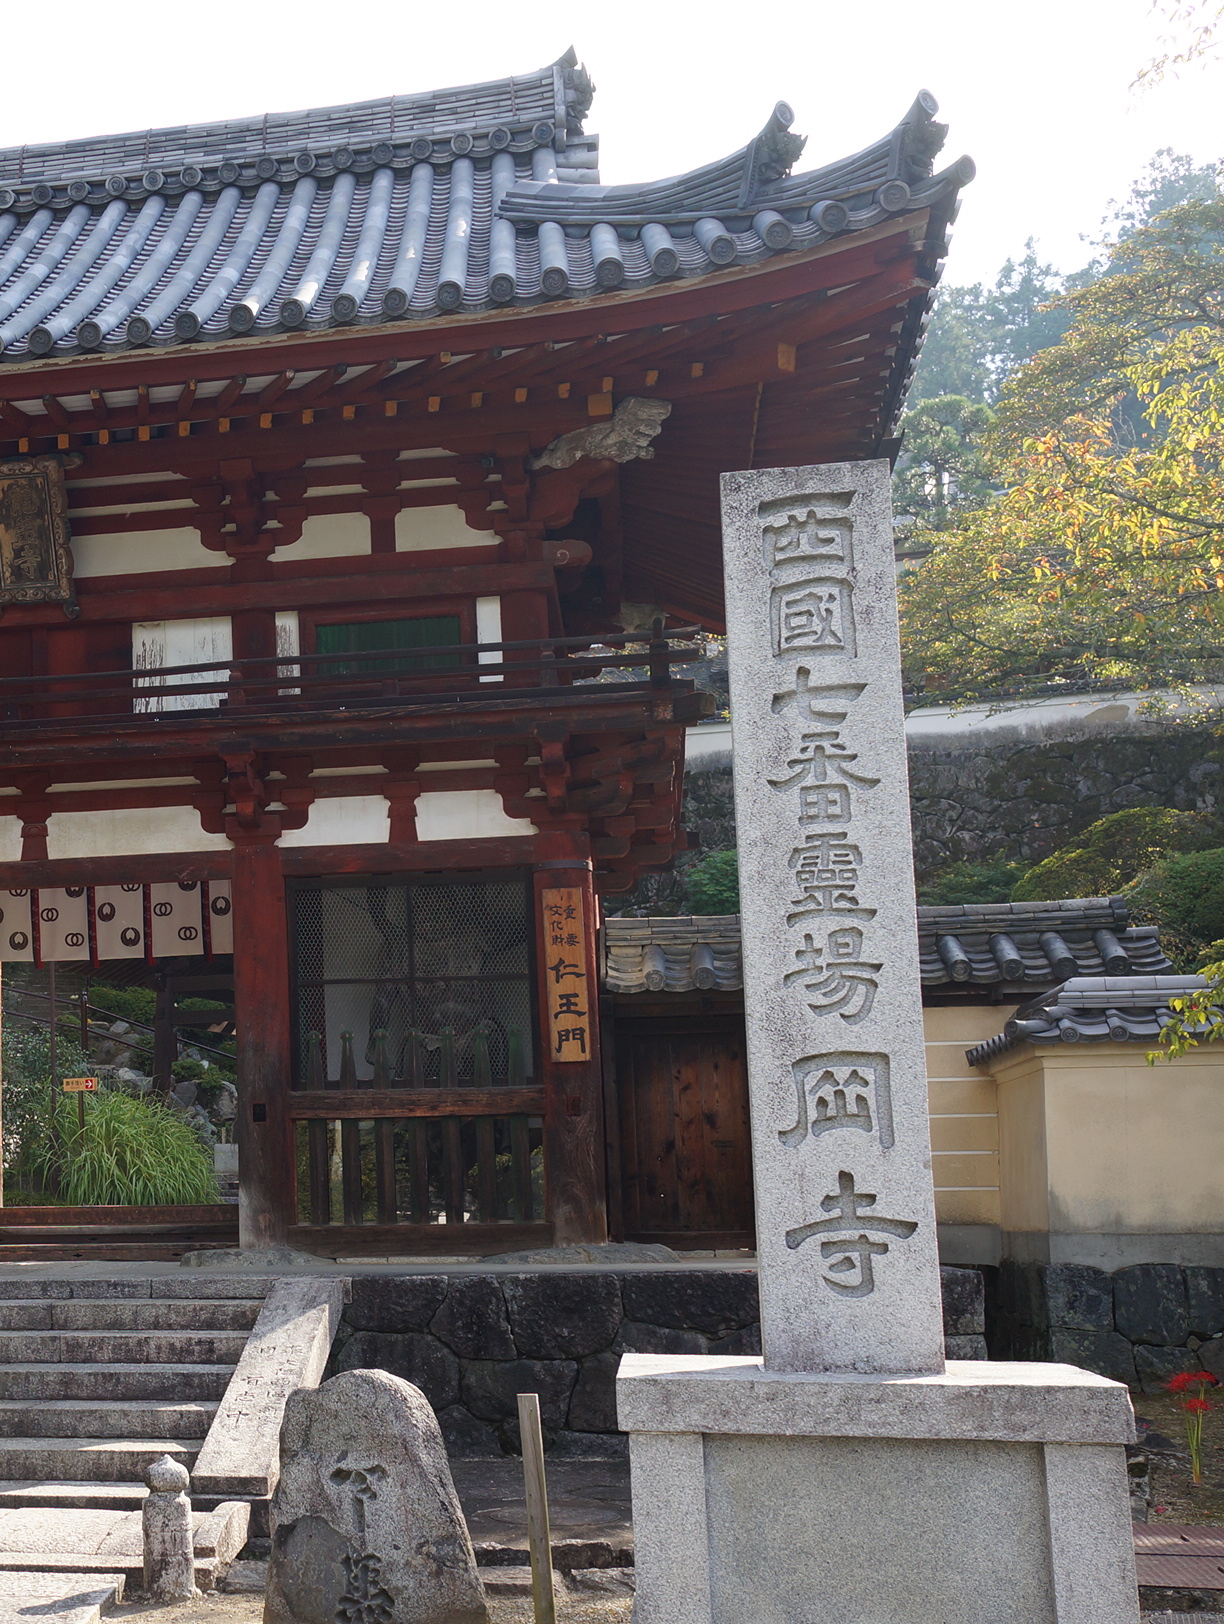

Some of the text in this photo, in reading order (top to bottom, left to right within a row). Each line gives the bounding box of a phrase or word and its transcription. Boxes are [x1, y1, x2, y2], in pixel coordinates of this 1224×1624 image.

[549, 904, 564, 947] 文化財
[563, 905, 580, 946] 重要
[548, 957, 587, 1054] 仁王門
